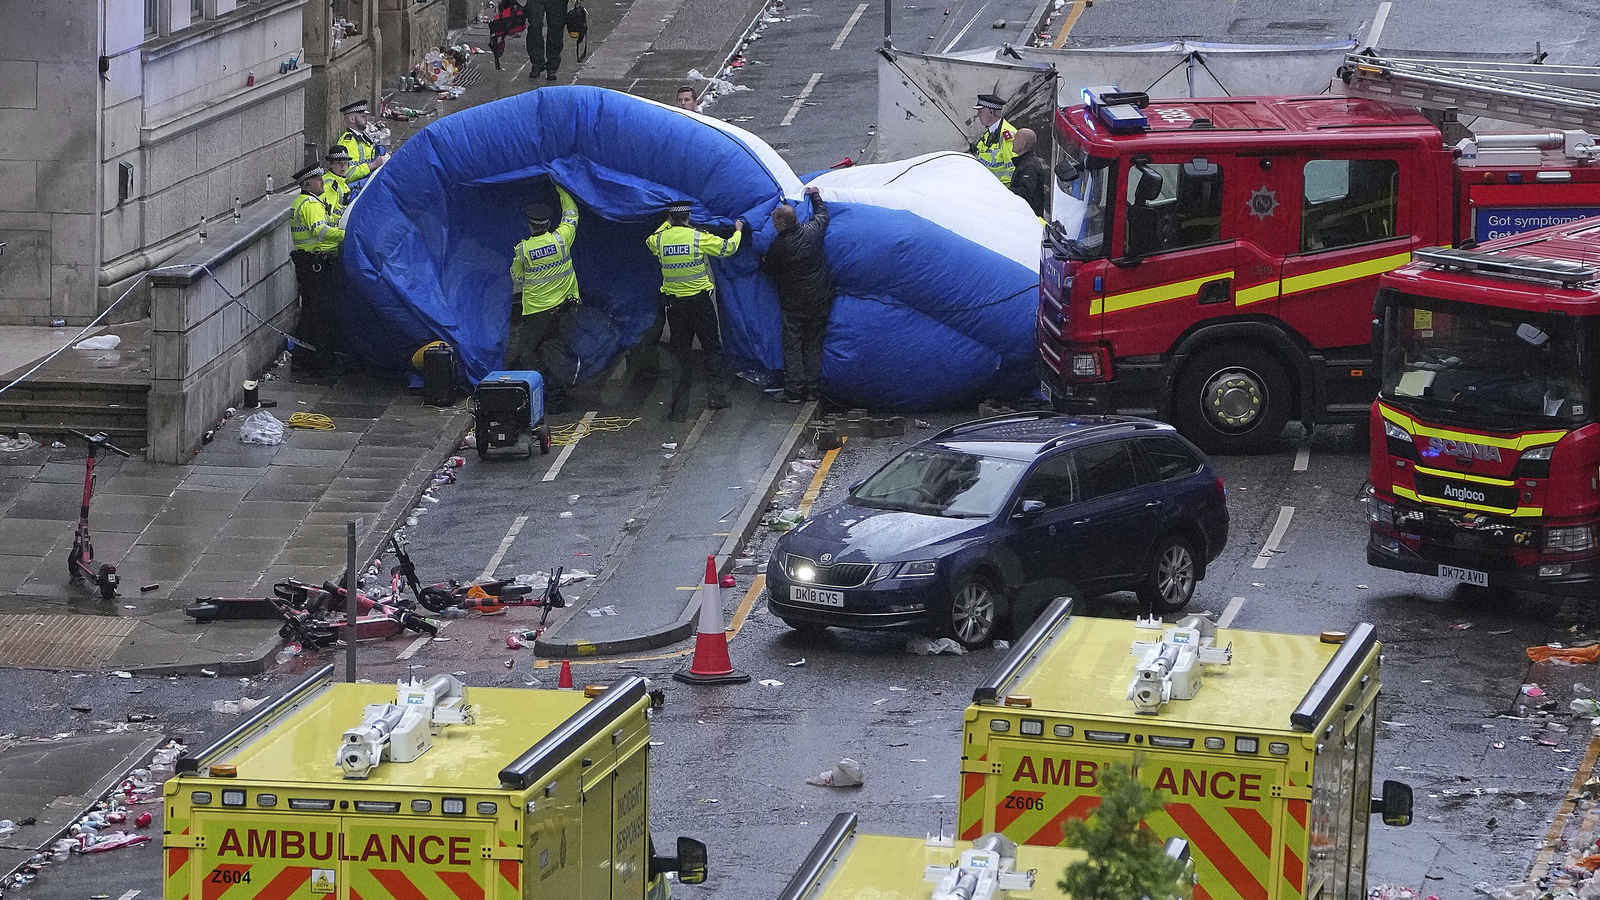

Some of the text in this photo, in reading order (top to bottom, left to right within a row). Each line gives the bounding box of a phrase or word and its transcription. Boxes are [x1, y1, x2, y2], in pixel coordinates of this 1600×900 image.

[1488, 215, 1511, 226] Got
[529, 245, 557, 260] POLICE
[663, 245, 690, 256] POLICE
[1428, 437, 1502, 463] SCANIA
[1444, 484, 1485, 501] Angloco
[1442, 566, 1484, 584] DK72 AVU
[795, 588, 838, 604] DK18 CYS
[1005, 795, 1044, 811] Z606
[217, 828, 472, 866] AMBULANCE
[211, 869, 252, 884] Z604
